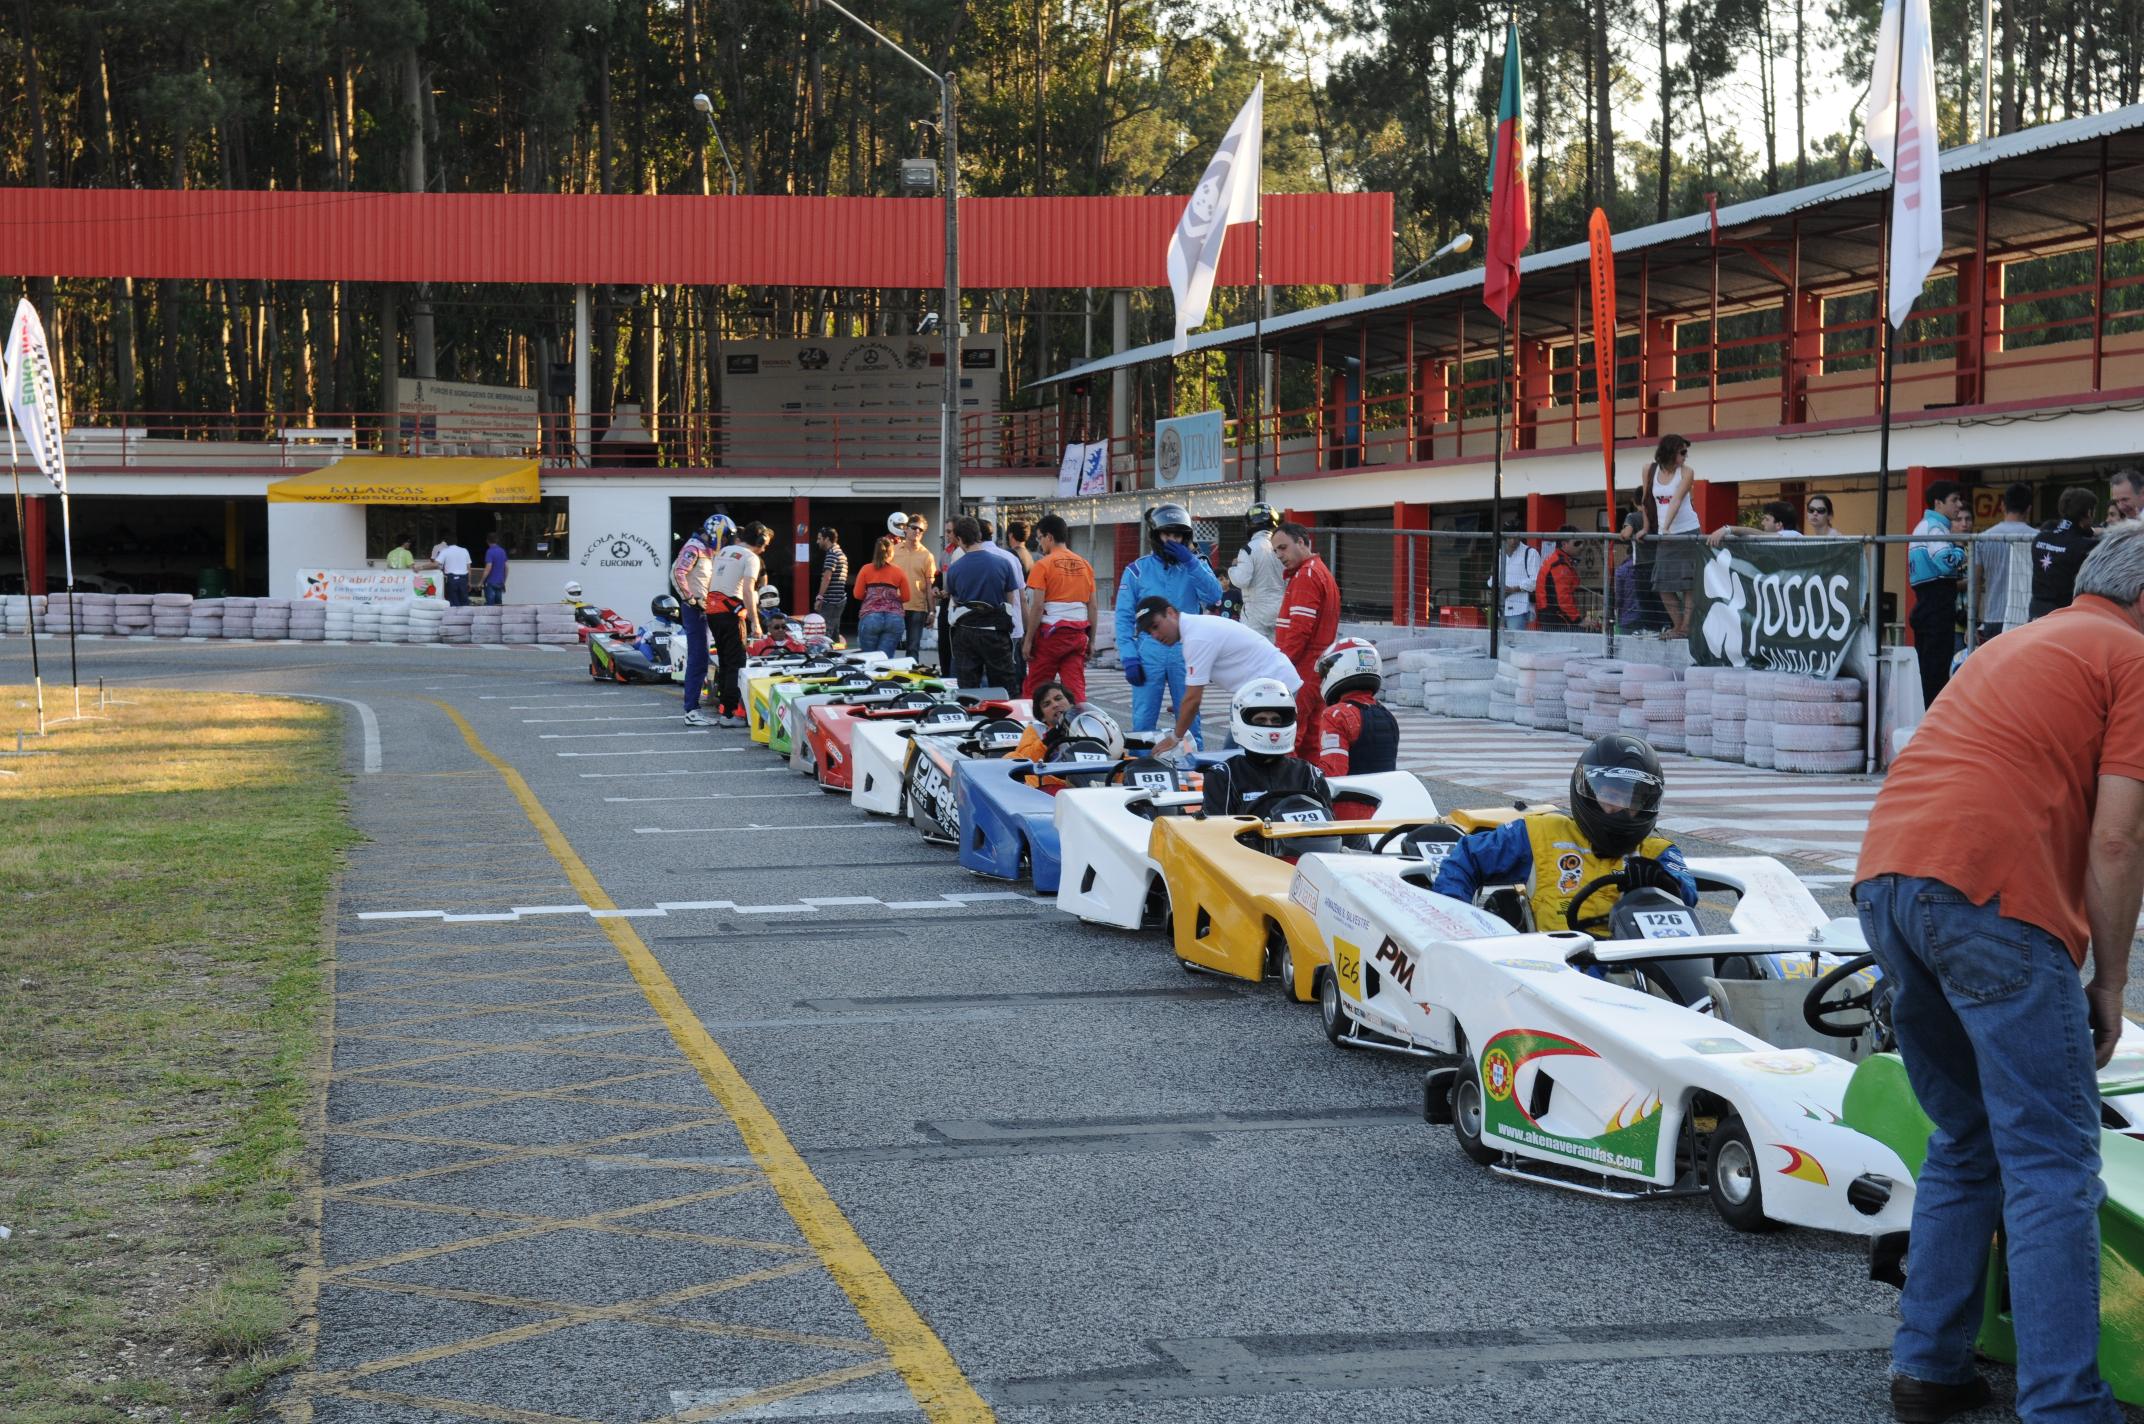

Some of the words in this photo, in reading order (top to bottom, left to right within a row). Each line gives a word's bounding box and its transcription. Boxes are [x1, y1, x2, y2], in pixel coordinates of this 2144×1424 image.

[1183, 421, 1220, 473] VERÃO
[580, 533, 615, 567] ESCOLA
[620, 532, 662, 568] KARTING
[599, 559, 644, 567] EUROINDY
[349, 575, 377, 584] abril
[379, 576, 408, 584] 2011
[1749, 574, 1851, 657] JOGOS
[1081, 753, 1101, 761] 127
[1141, 773, 1166, 783] 88
[1290, 811, 1319, 822] 129
[1425, 843, 1455, 855] 67
[1641, 914, 1682, 926] 126
[1338, 952, 1360, 984] 126
[1498, 1122, 1644, 1172] www.akenaverandas.com
